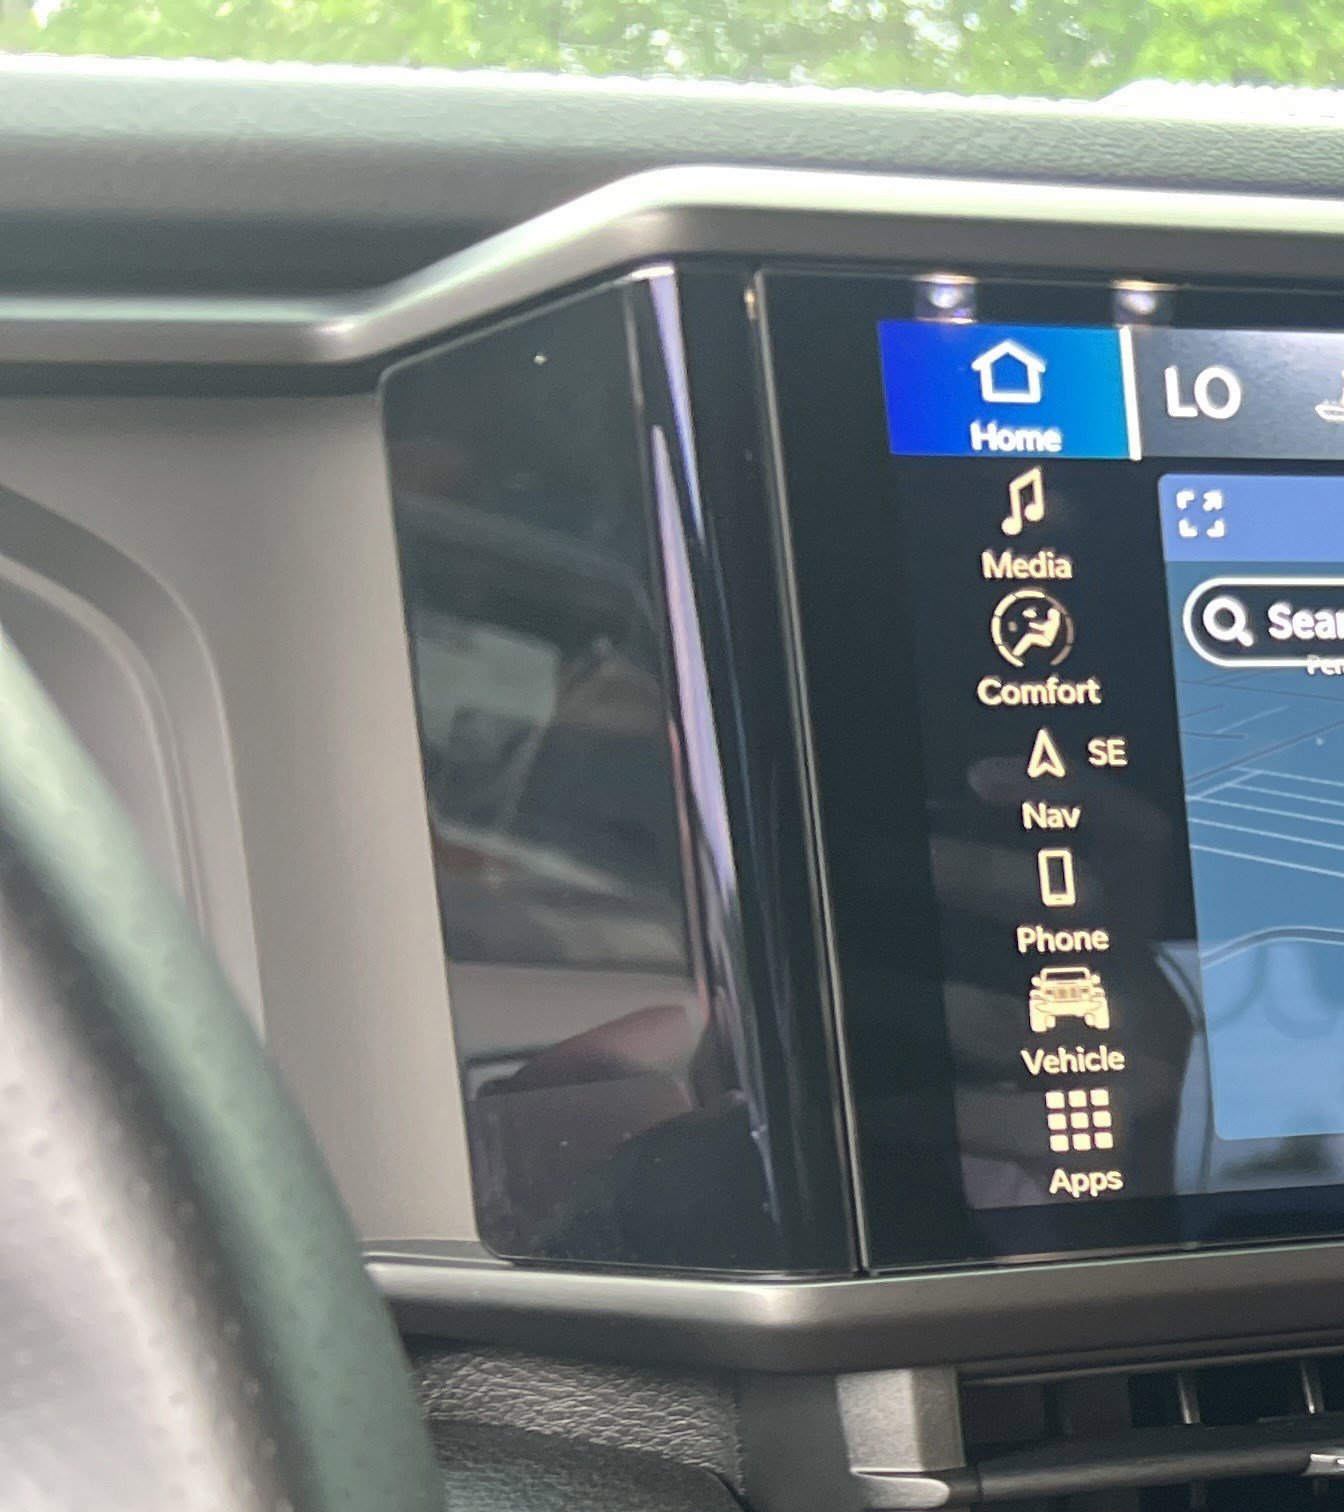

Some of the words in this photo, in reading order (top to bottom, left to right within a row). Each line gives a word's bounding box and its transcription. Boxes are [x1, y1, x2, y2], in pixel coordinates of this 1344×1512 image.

[1164, 366, 1242, 419] LO
[970, 421, 1062, 452] Home
[982, 550, 1073, 580] Media
[977, 676, 1101, 706] Comfort
[1087, 739, 1128, 767] SE
[1022, 802, 1081, 829] Nav
[1017, 926, 1110, 953] Phone
[1021, 1047, 1126, 1075] Vehicle
[1049, 1169, 1124, 1197] Apps
